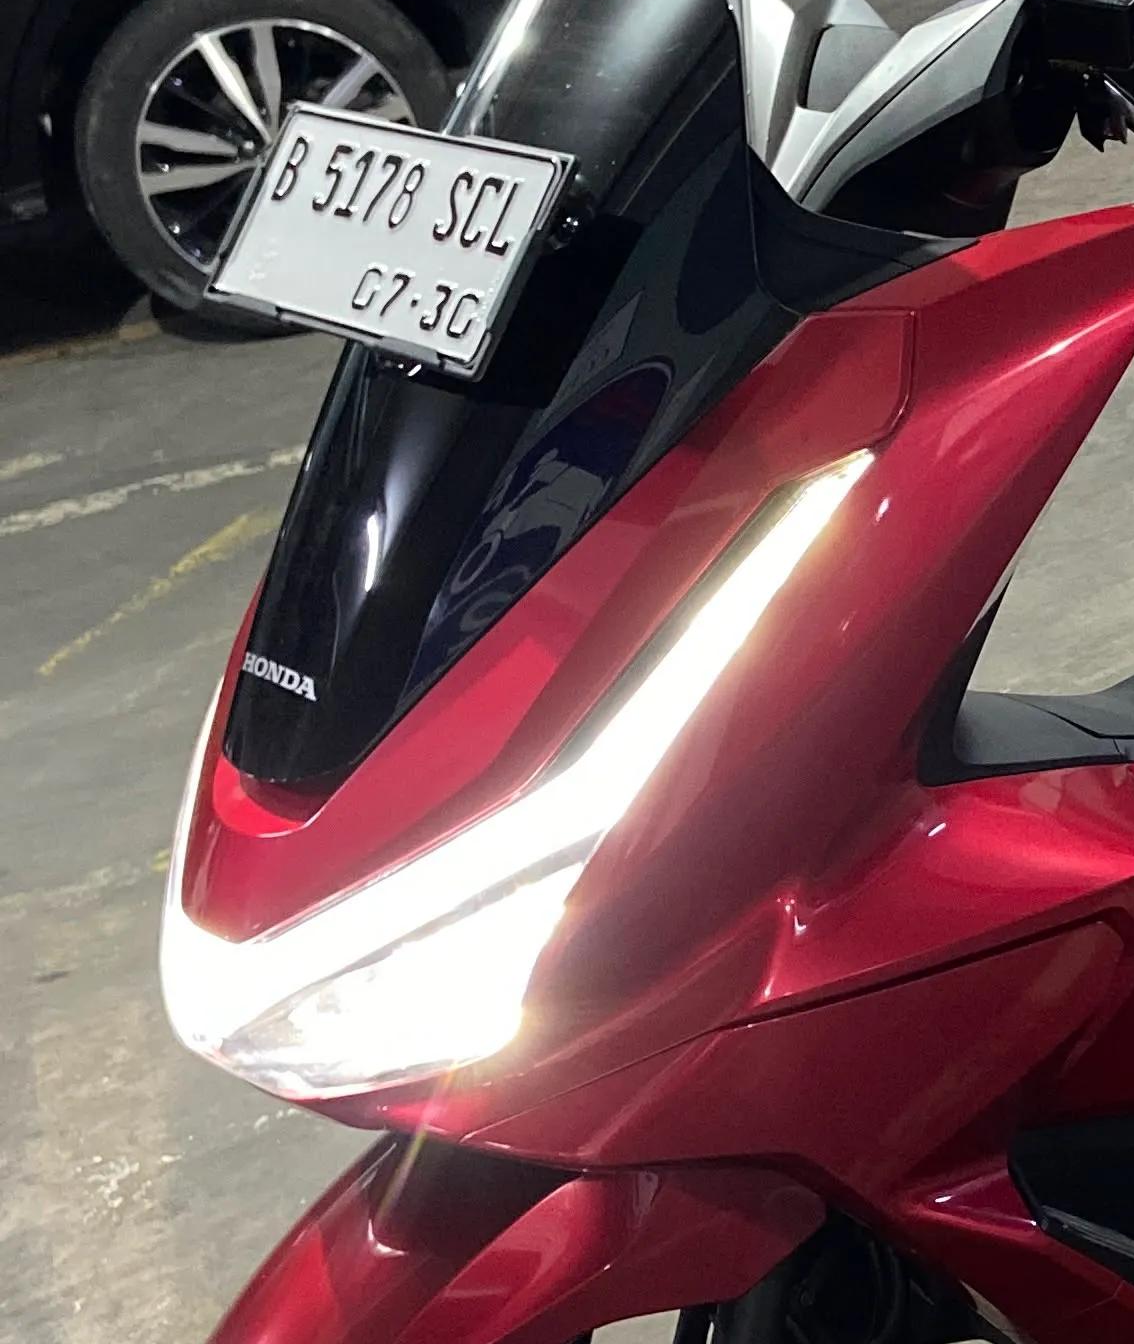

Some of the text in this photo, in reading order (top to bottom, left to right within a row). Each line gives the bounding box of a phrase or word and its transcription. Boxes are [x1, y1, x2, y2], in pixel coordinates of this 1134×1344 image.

[270, 136, 522, 258] B 5178 SCL
[242, 652, 318, 703] HONDA
